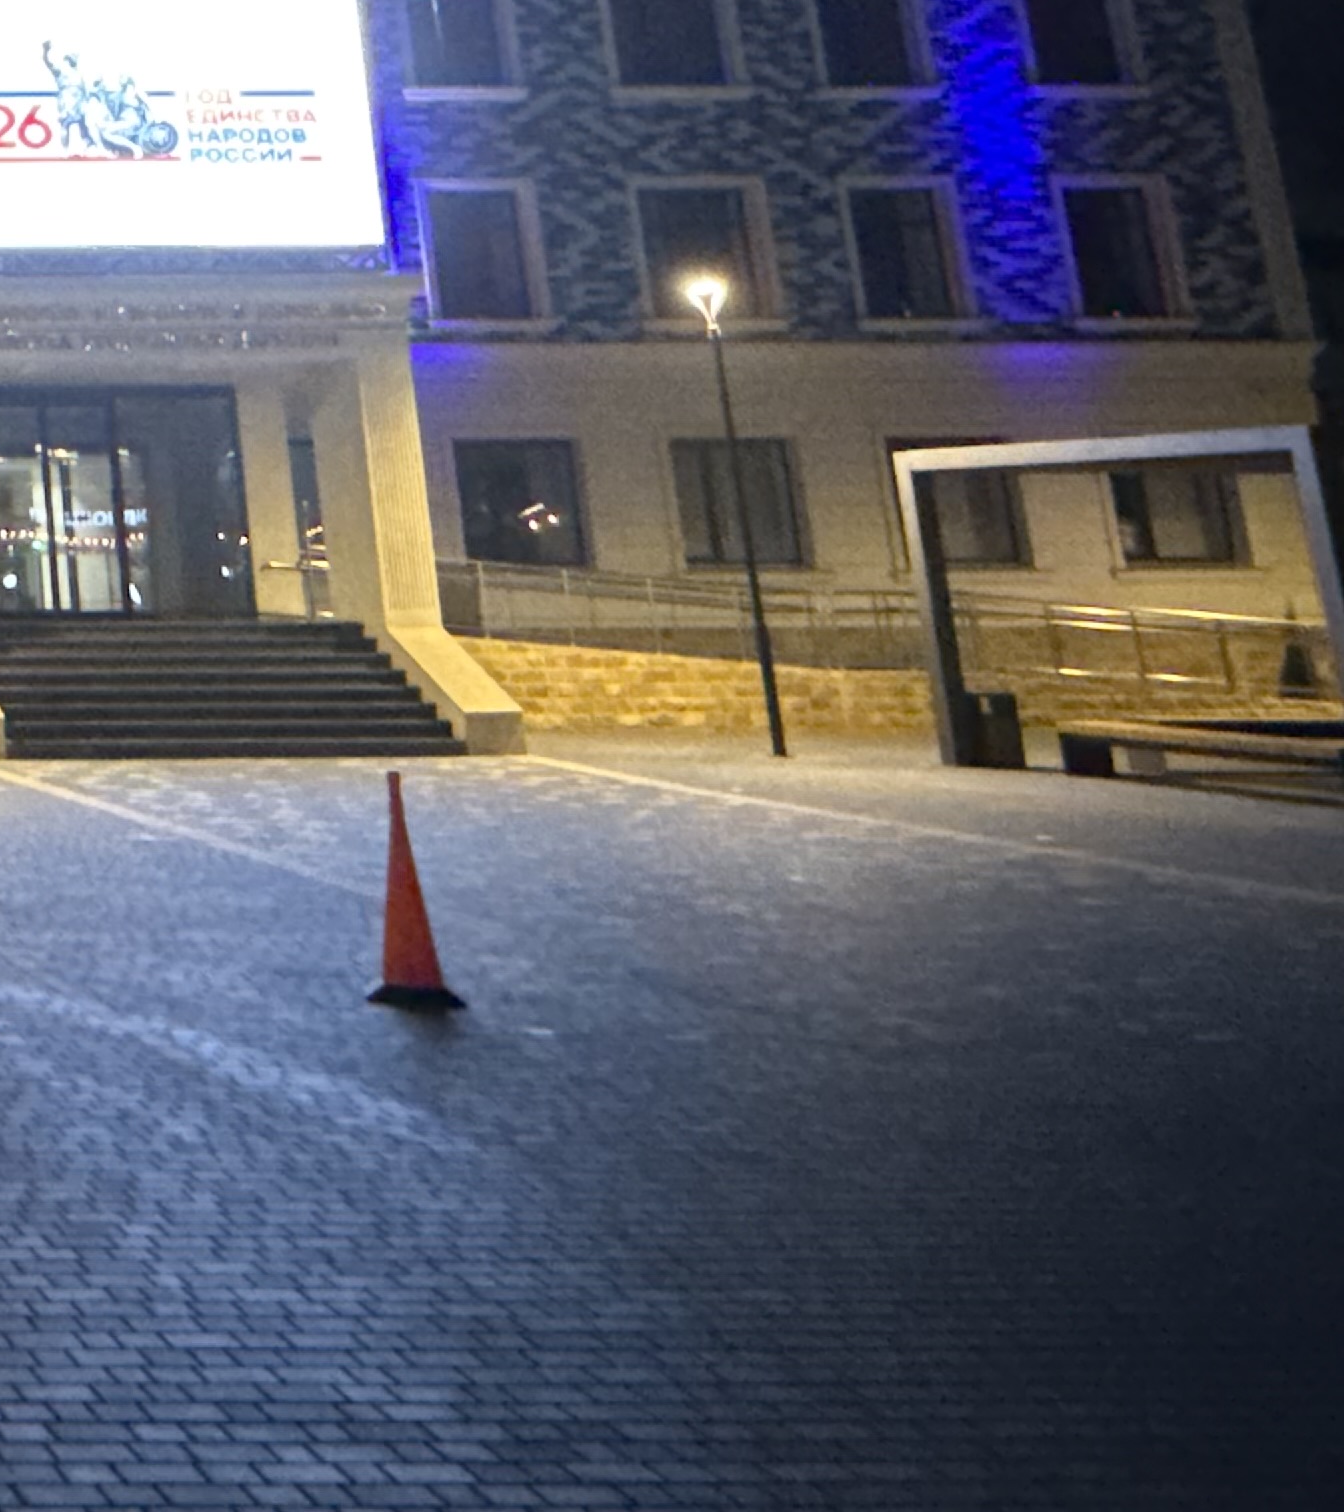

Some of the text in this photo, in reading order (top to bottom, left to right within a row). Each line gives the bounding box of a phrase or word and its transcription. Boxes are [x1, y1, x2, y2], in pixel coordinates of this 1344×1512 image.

[186, 109, 317, 124] ЕДИНСТВА
[188, 128, 307, 144] НАРОДОВ
[190, 148, 292, 163] РОССИИ
